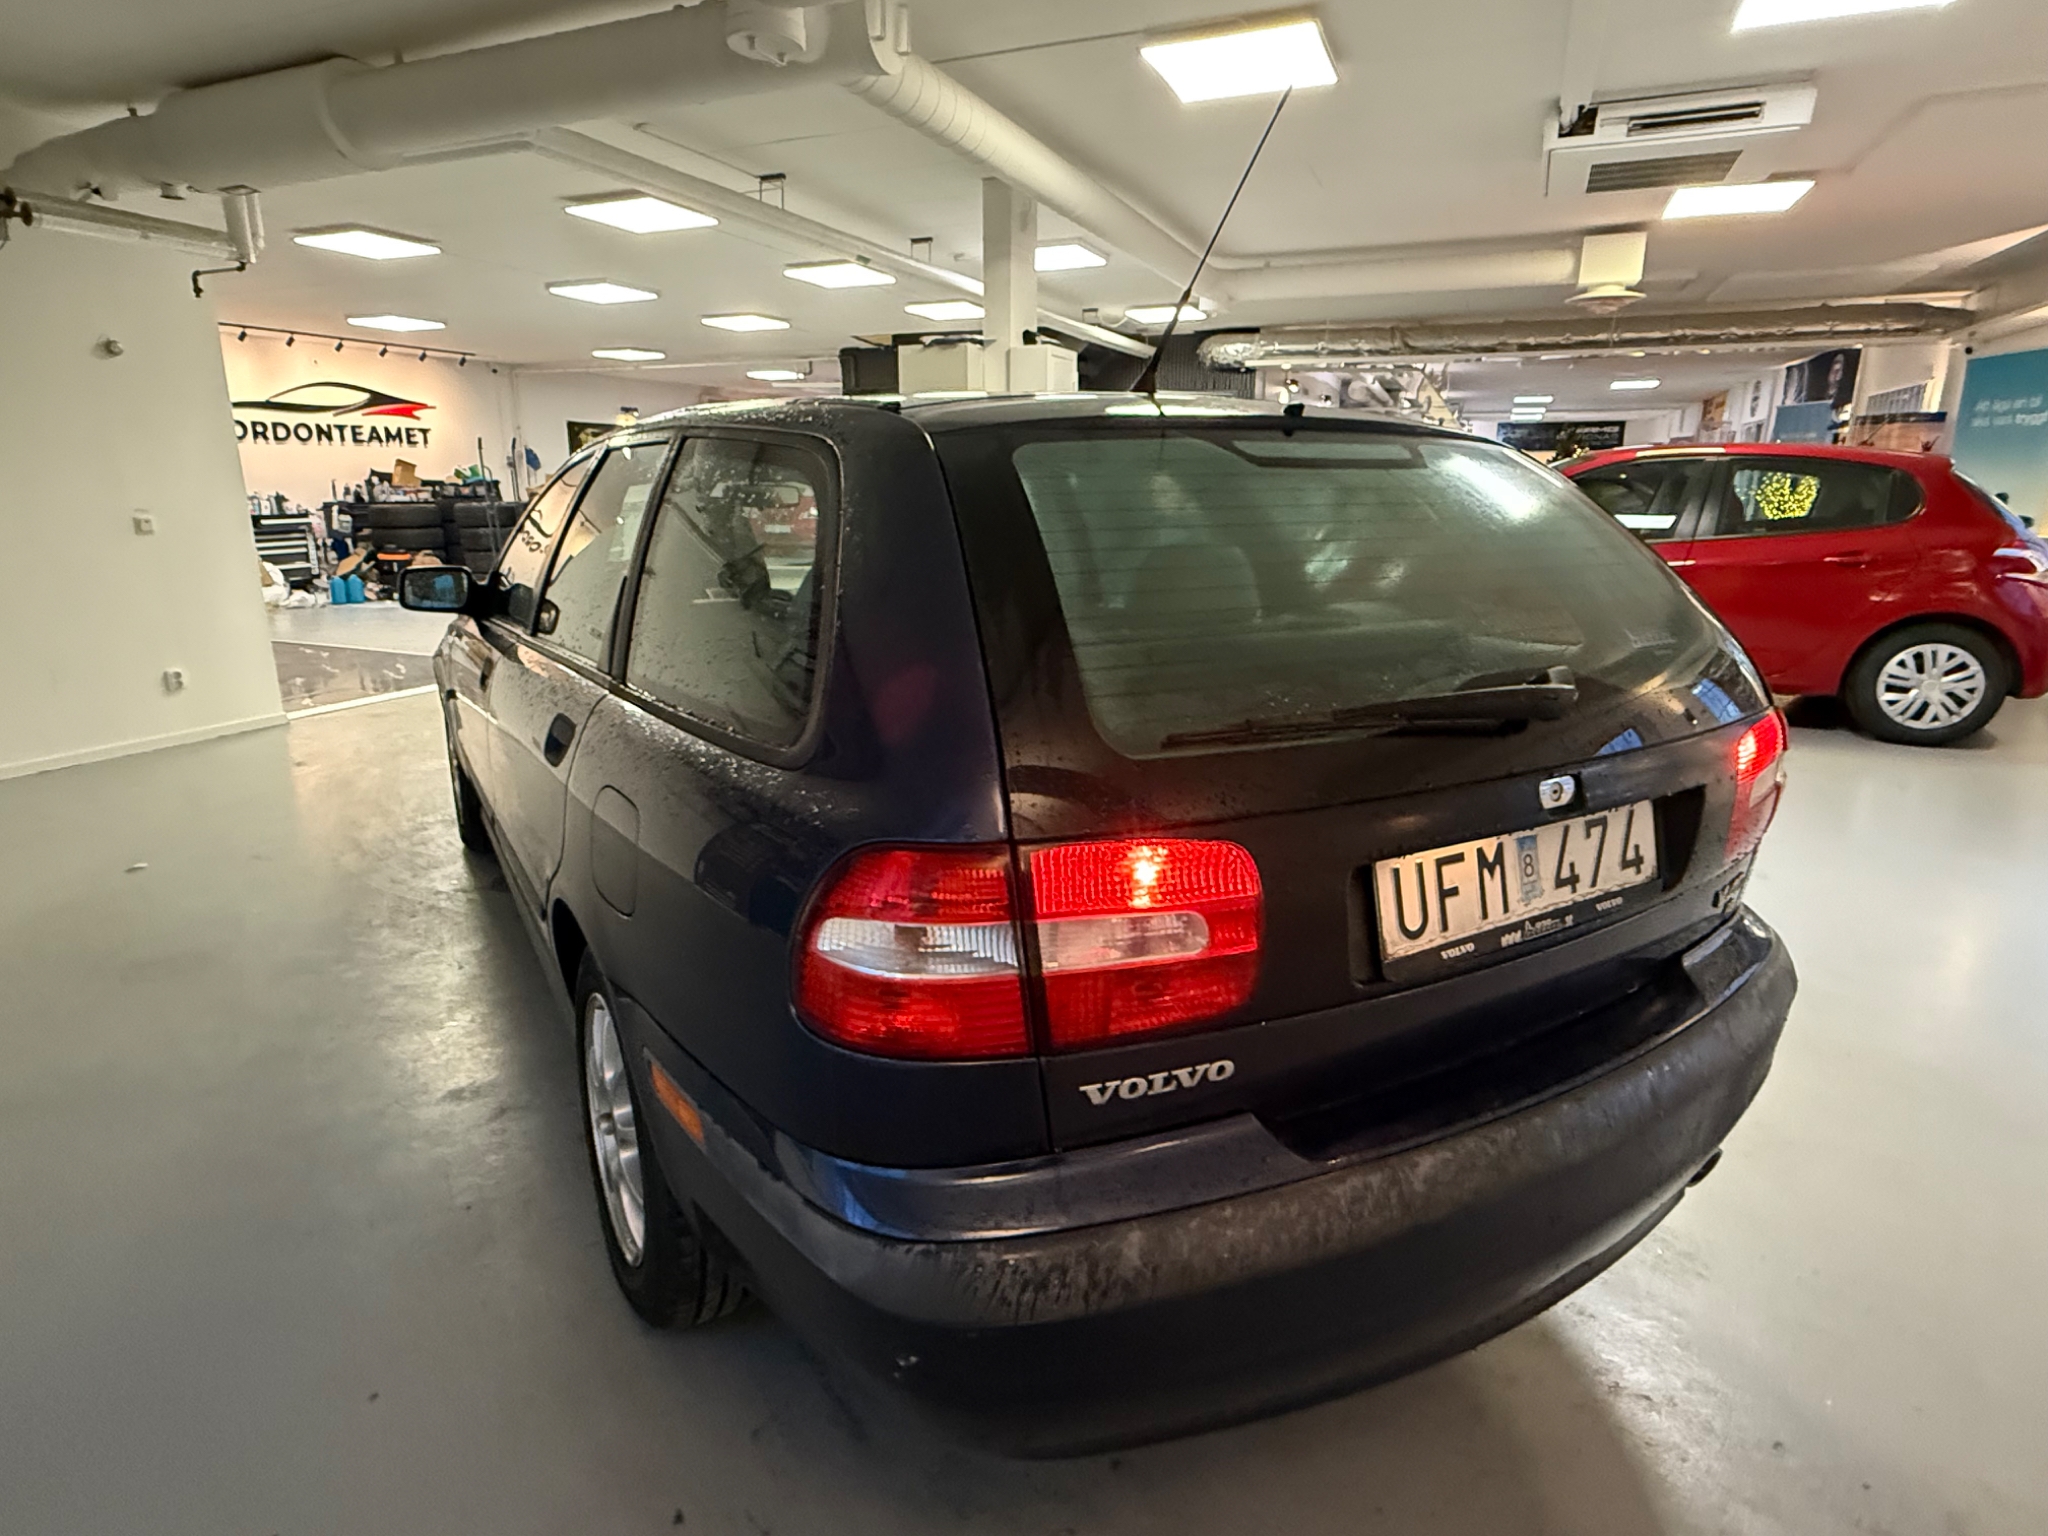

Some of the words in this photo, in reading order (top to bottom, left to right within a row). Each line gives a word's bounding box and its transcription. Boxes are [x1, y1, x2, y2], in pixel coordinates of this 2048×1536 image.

[1393, 841, 1510, 940] UFM
[1554, 807, 1645, 894] 474
[1079, 1060, 1235, 1105] VOLVO
